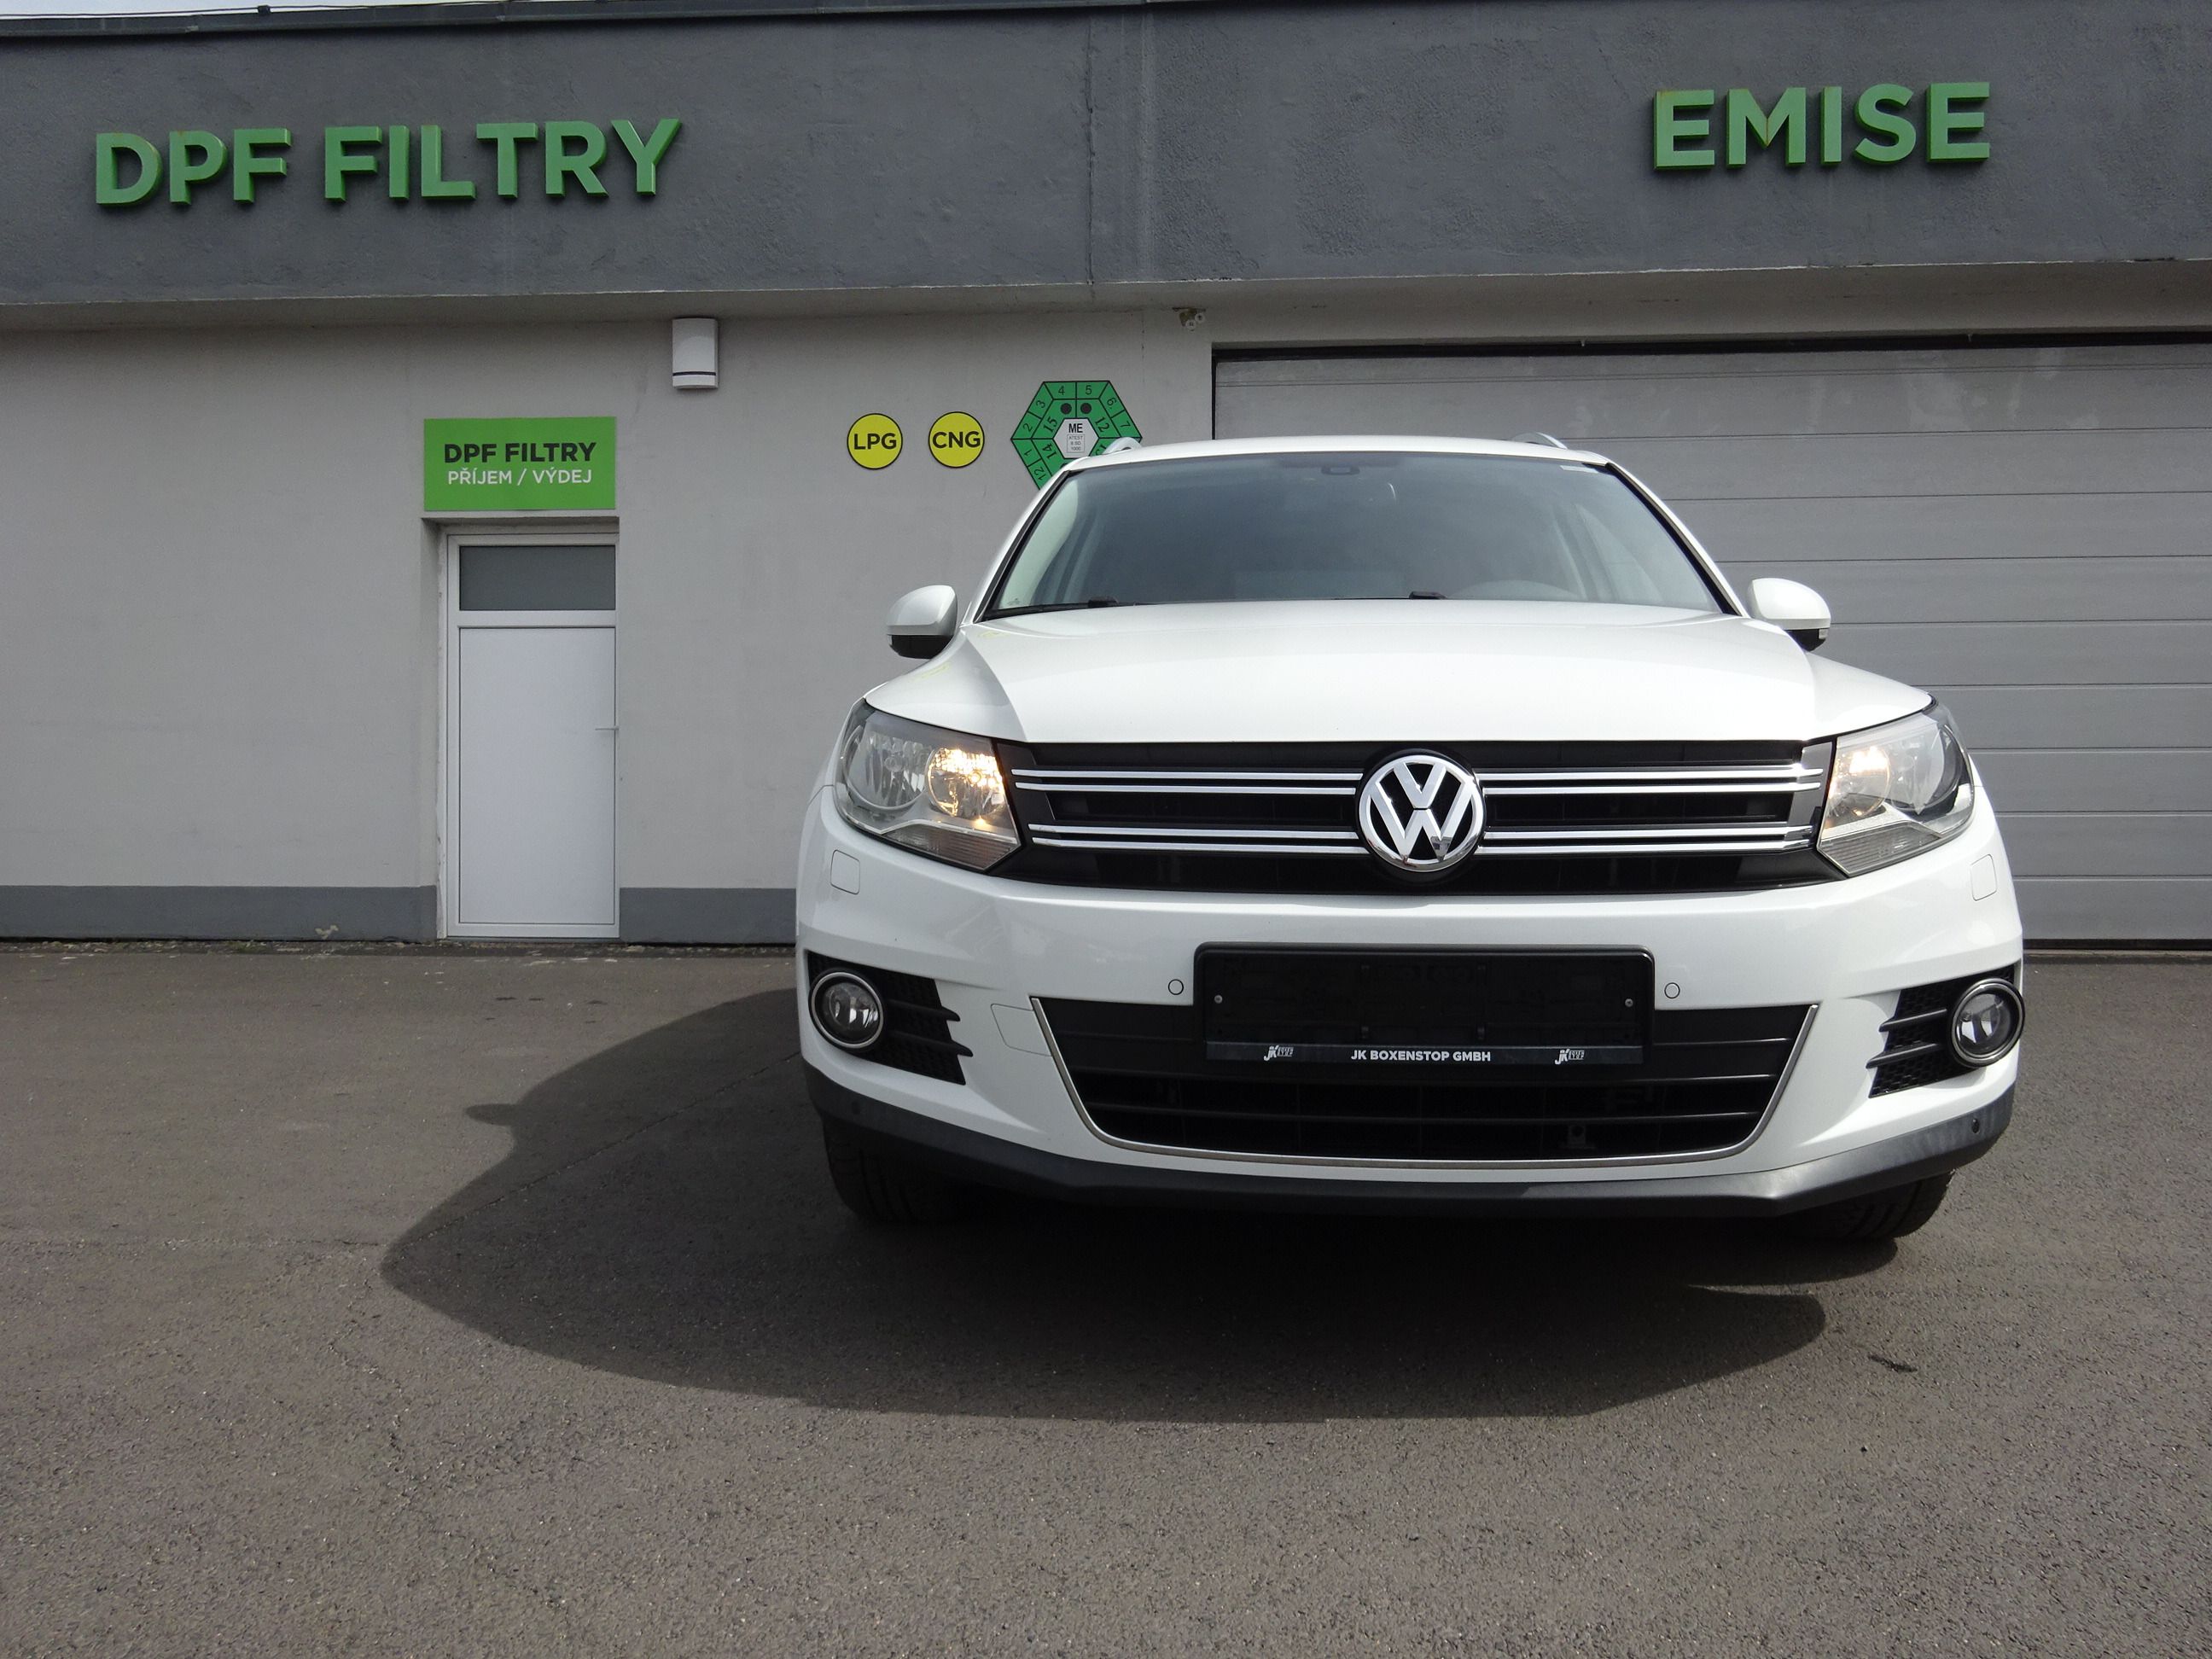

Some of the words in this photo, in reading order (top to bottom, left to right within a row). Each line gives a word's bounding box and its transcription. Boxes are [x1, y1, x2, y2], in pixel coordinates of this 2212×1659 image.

[1654, 82, 1990, 169] EMISE
[96, 127, 292, 206] DPF
[324, 119, 682, 202] FILTRY
[1058, 386, 1066, 395] 4
[1085, 385, 1092, 395] 5
[1035, 399, 1046, 409] 3
[1022, 422, 1033, 433] 2
[1043, 416, 1057, 433] 15
[1068, 422, 1084, 434] ME
[1095, 416, 1110, 433] 12
[853, 433, 897, 450] LPG
[932, 431, 981, 449] CNG
[444, 443, 497, 463] DPF
[505, 442, 597, 462] FILTRY
[1042, 443, 1057, 459] 14
[448, 467, 512, 485] PŘÍJEM
[517, 469, 527, 486] /
[533, 467, 592, 484] VÝDEJ
[1033, 466, 1046, 480] 12
[1361, 757, 1481, 867] VW
[1351, 1050, 1367, 1060] JK
[1370, 1050, 1449, 1061] BOXENSTOP
[1452, 1051, 1491, 1062] GMBH
